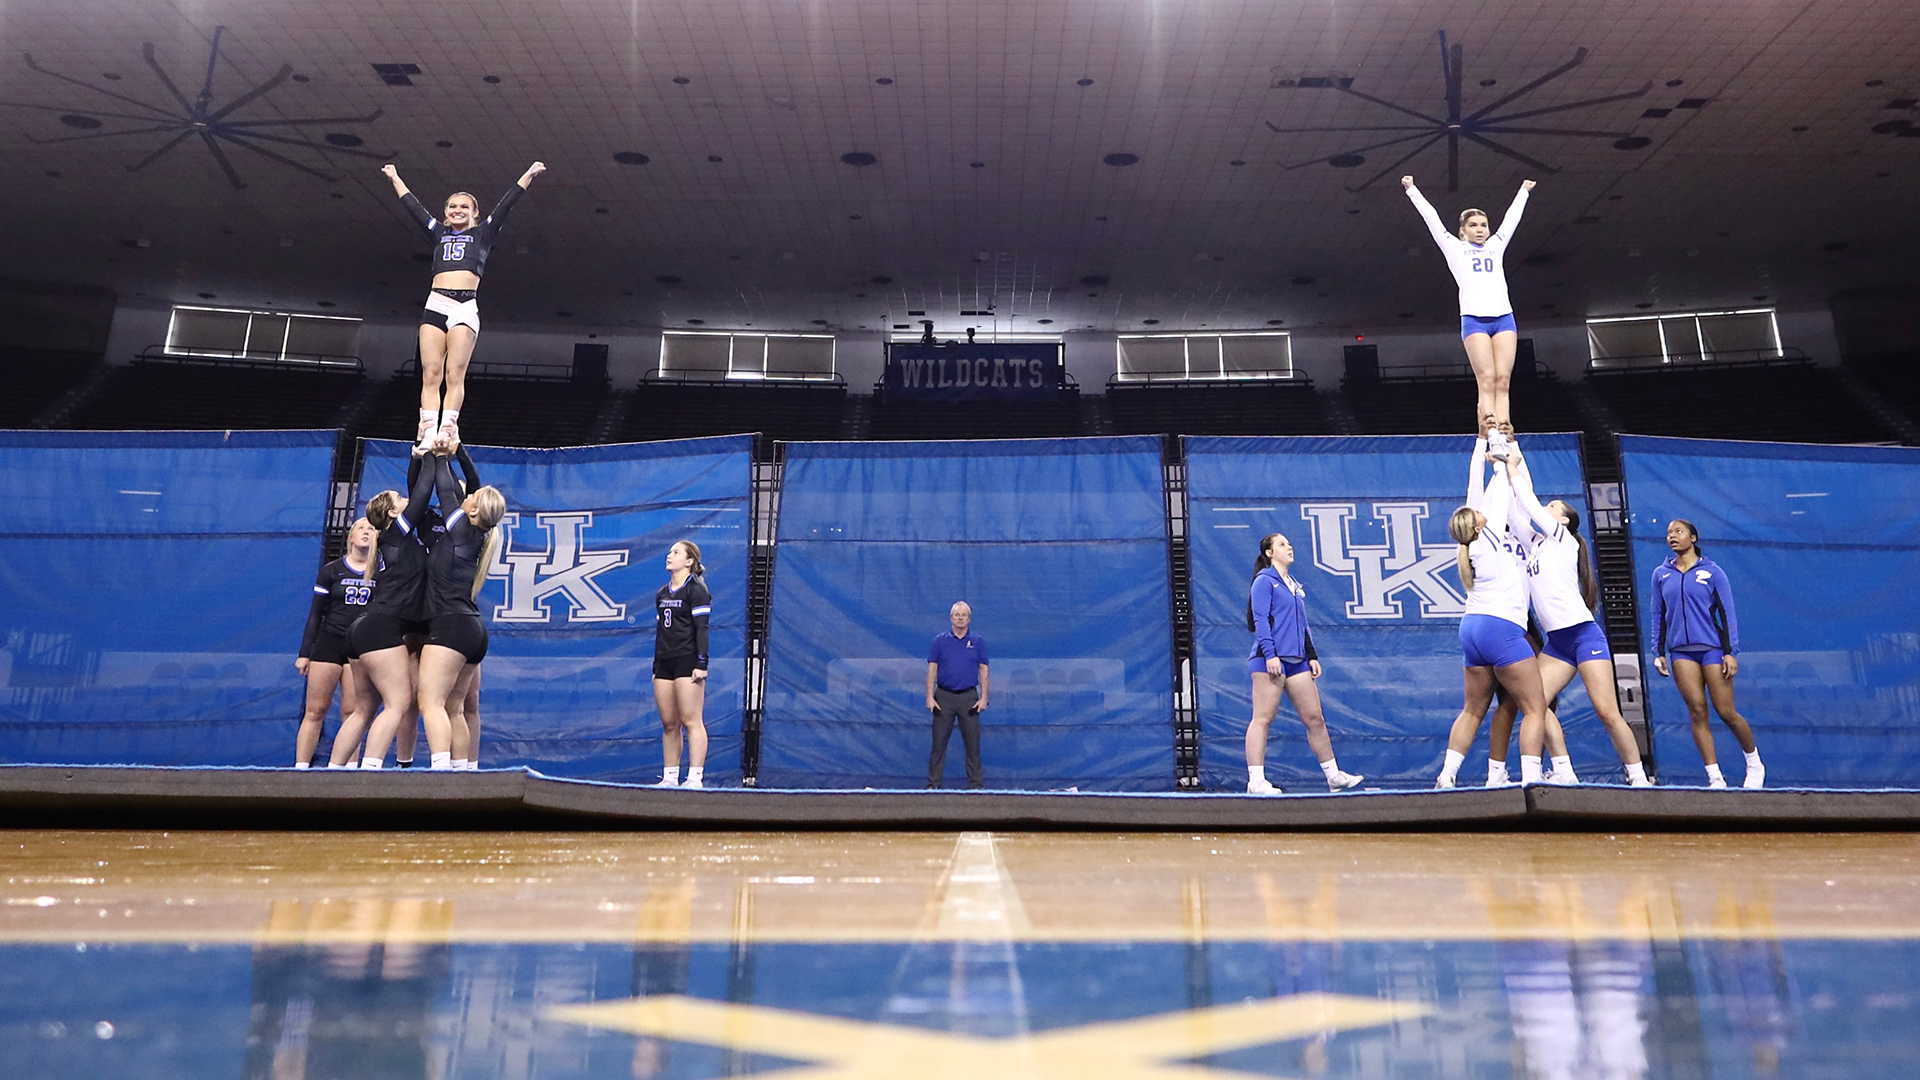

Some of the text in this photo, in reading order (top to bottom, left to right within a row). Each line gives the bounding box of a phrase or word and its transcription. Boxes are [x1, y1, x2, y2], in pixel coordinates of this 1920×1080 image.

[443, 243, 466, 261] 15
[1472, 257, 1493, 272] 20
[901, 358, 1043, 388] WILDCATS
[485, 511, 630, 623] UK
[1301, 502, 1467, 619] UK
[345, 586, 371, 606] 23
[663, 608, 672, 628] 3
